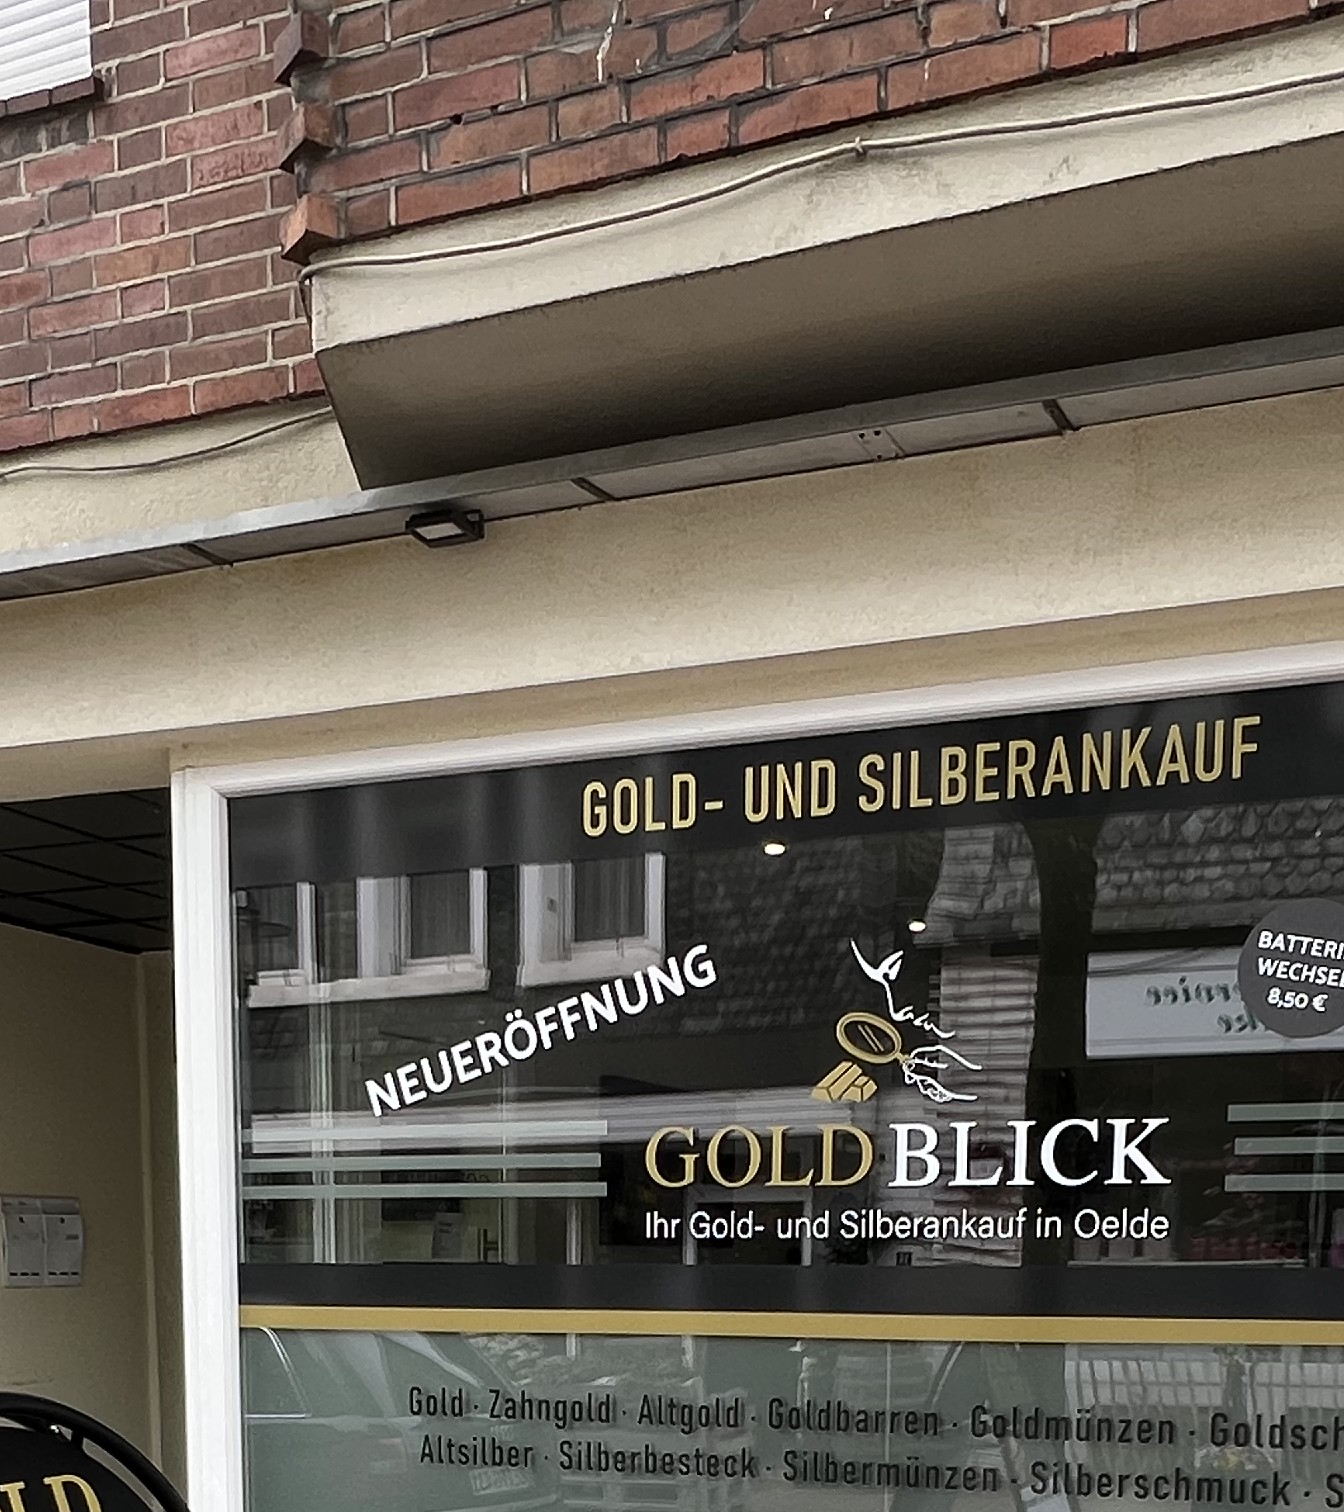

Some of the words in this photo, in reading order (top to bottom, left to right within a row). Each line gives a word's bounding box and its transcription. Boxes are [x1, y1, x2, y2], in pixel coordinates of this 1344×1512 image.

[583, 772, 723, 837] GOLD-
[745, 759, 835, 822] UND
[858, 714, 1262, 812] SILBERANKAUF
[364, 945, 718, 1117] NEUERÖFFNUNG
[1267, 987, 1309, 1008] 8,50
[1312, 994, 1328, 1011] €
[644, 1122, 874, 1188] GOLD
[888, 1119, 1172, 1188] BLICK
[645, 1212, 679, 1239] Ihr
[690, 1210, 765, 1240] Gold-
[776, 1210, 830, 1240] und
[840, 1208, 1026, 1240] Silberankauf
[1036, 1211, 1061, 1239] in
[1074, 1209, 1170, 1240] Oelde
[408, 1387, 464, 1418] Gold
[489, 1389, 611, 1430] Zahngold
[637, 1395, 739, 1435] Altgold
[768, 1399, 938, 1437] Goldbarren
[970, 1405, 1176, 1445] Goldmünzen
[420, 1434, 534, 1469] Altsilber
[559, 1441, 756, 1479] Silberbesteck
[782, 1451, 997, 1492] Silbermünzen
[1030, 1461, 1291, 1507] Silberschmuck
